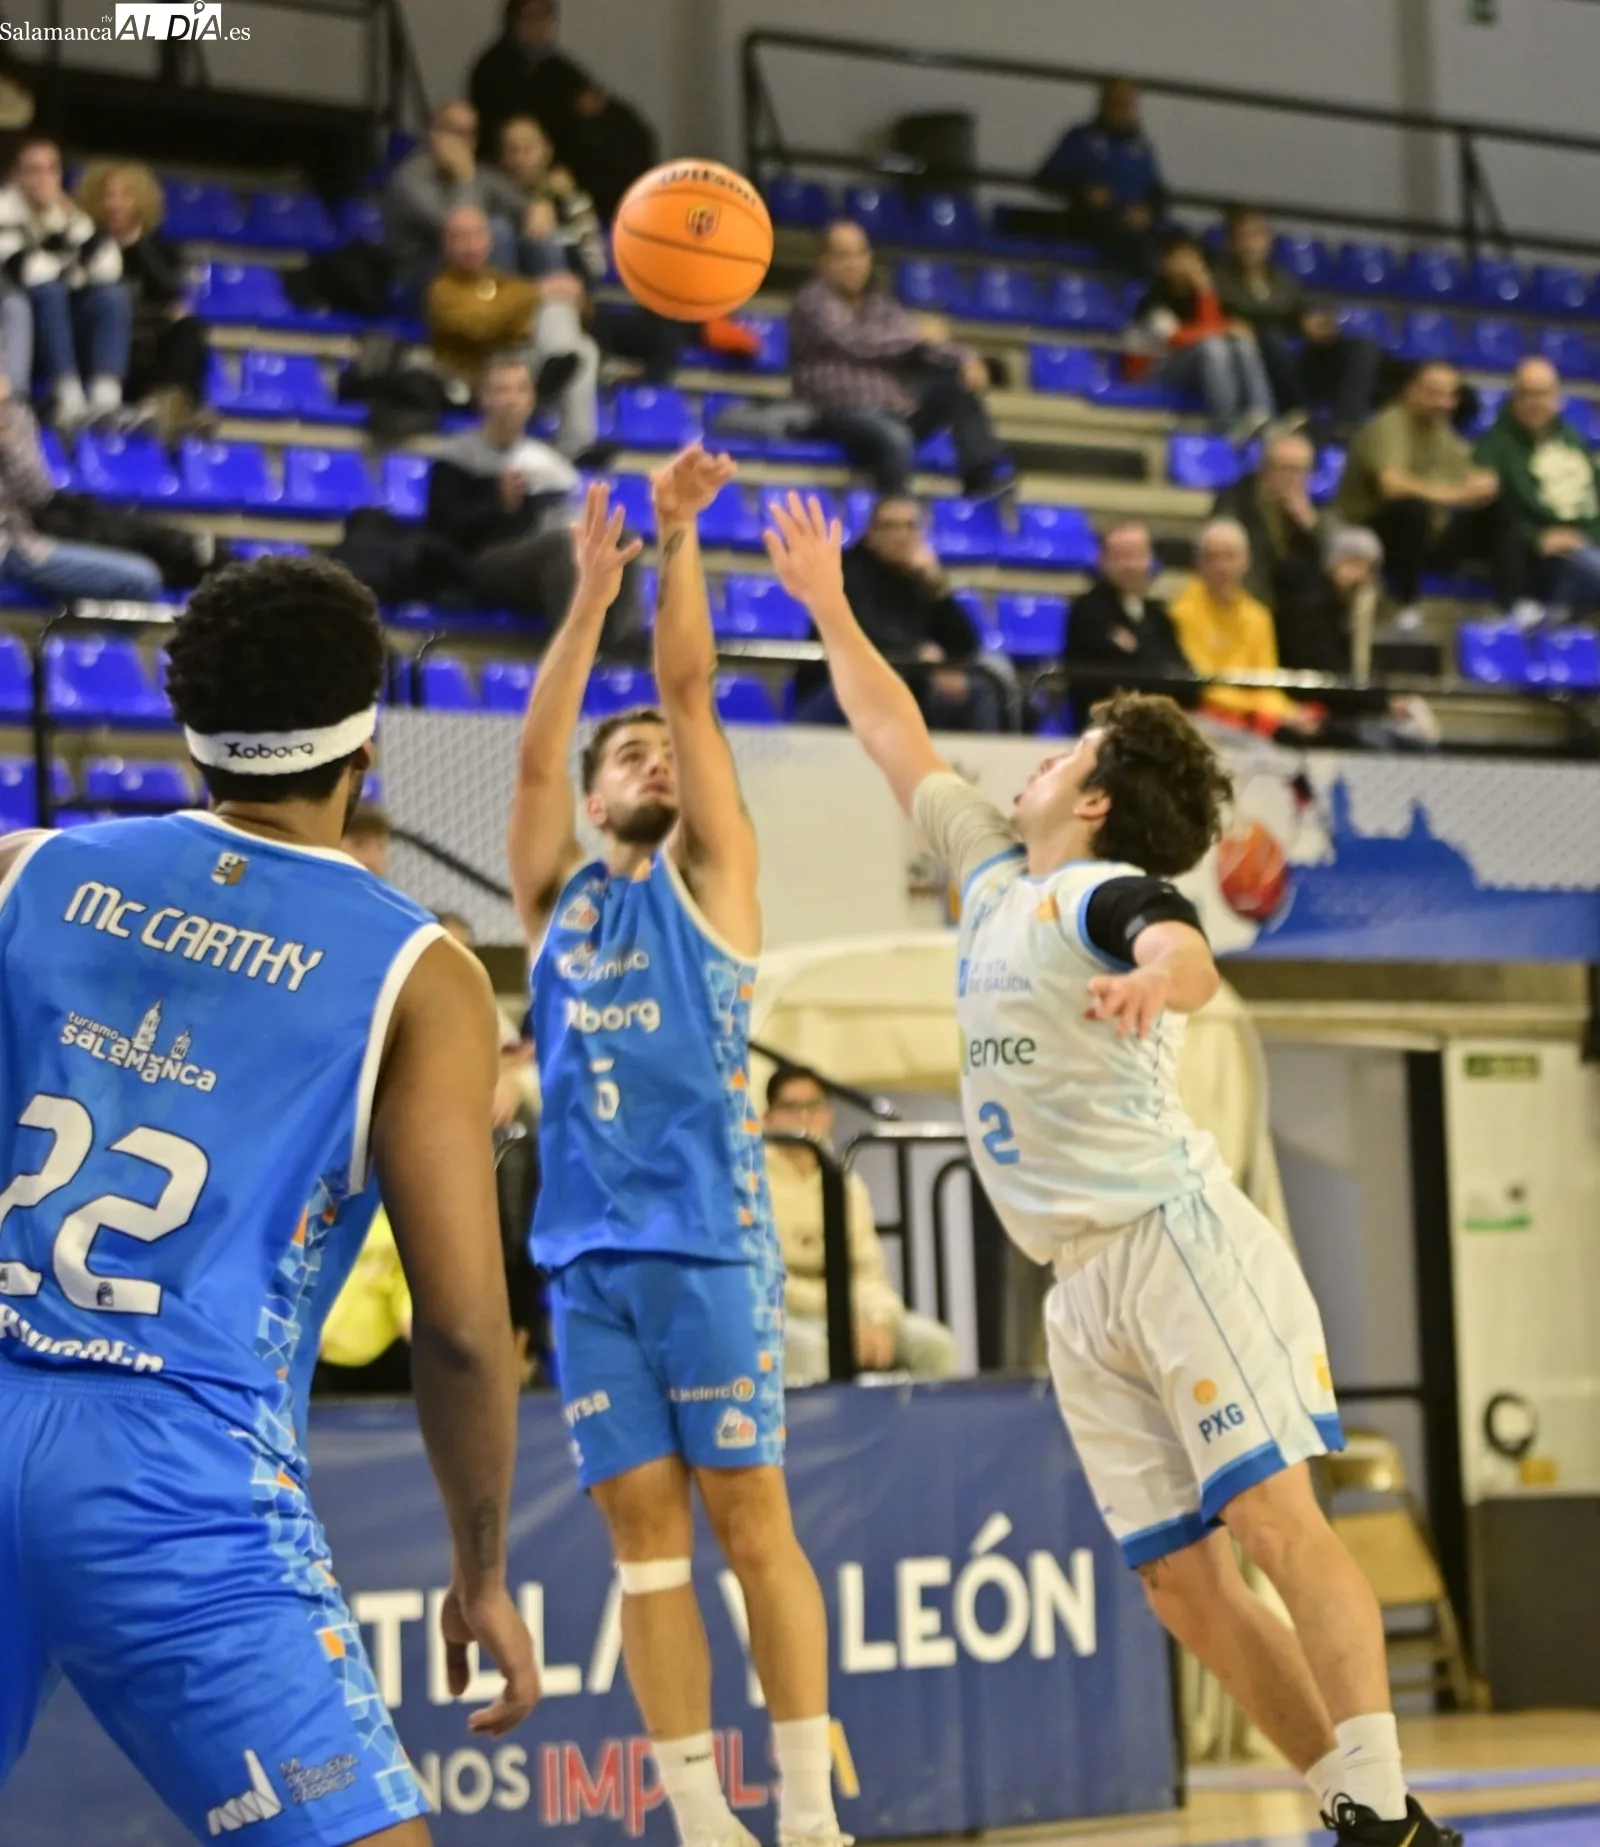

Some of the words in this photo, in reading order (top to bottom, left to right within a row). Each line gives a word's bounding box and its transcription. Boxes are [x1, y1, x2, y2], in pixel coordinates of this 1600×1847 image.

[139, 906, 325, 993] CARTHY
[68, 1010, 119, 1040] turismo
[978, 1101, 1020, 1165] 2
[0, 1093, 209, 1317] 22
[1198, 1403, 1244, 1444] PXG
[838, 1512, 1097, 1674] LEÓN
